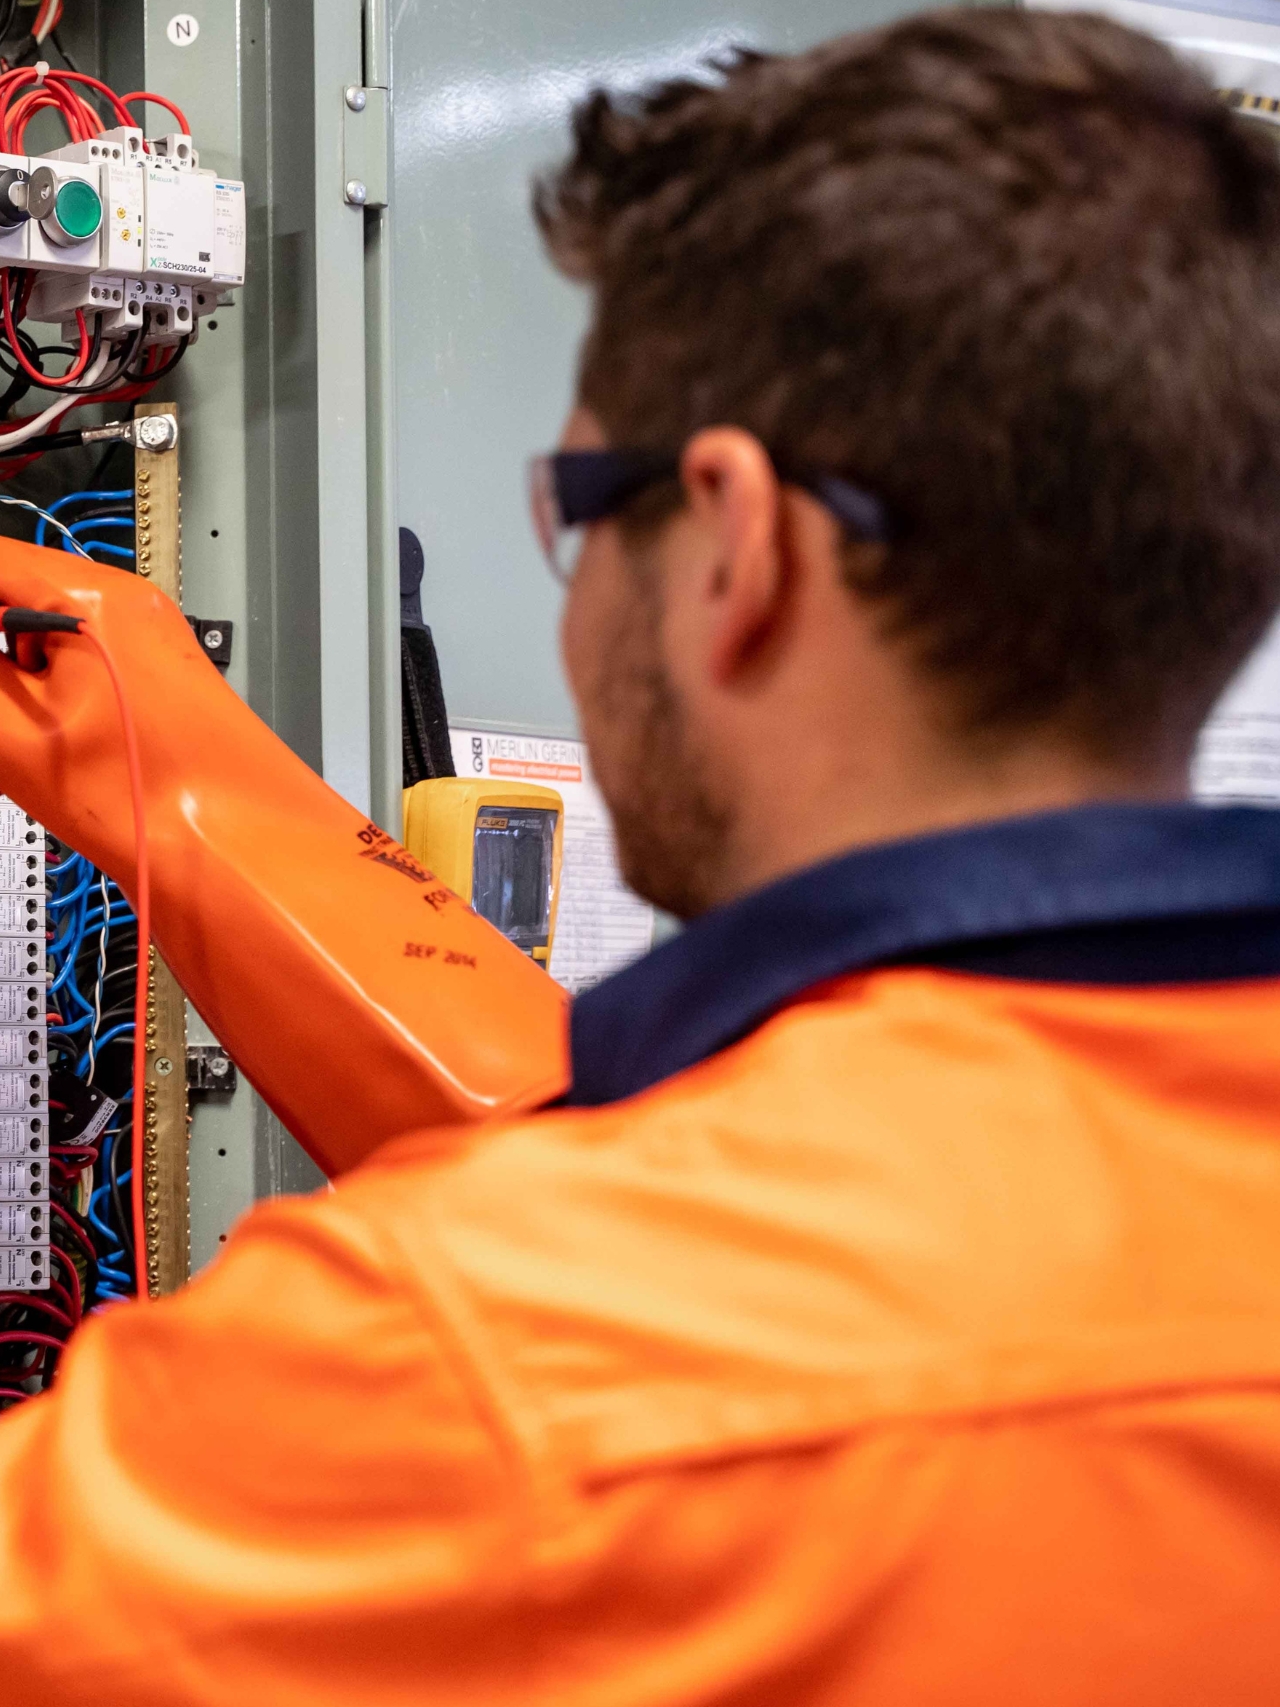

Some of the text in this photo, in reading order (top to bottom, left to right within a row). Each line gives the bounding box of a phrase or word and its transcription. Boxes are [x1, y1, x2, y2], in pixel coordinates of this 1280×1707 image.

[176, 21, 191, 39] N
[487, 739, 538, 759] MERLIN
[404, 942, 437, 958] SEP
